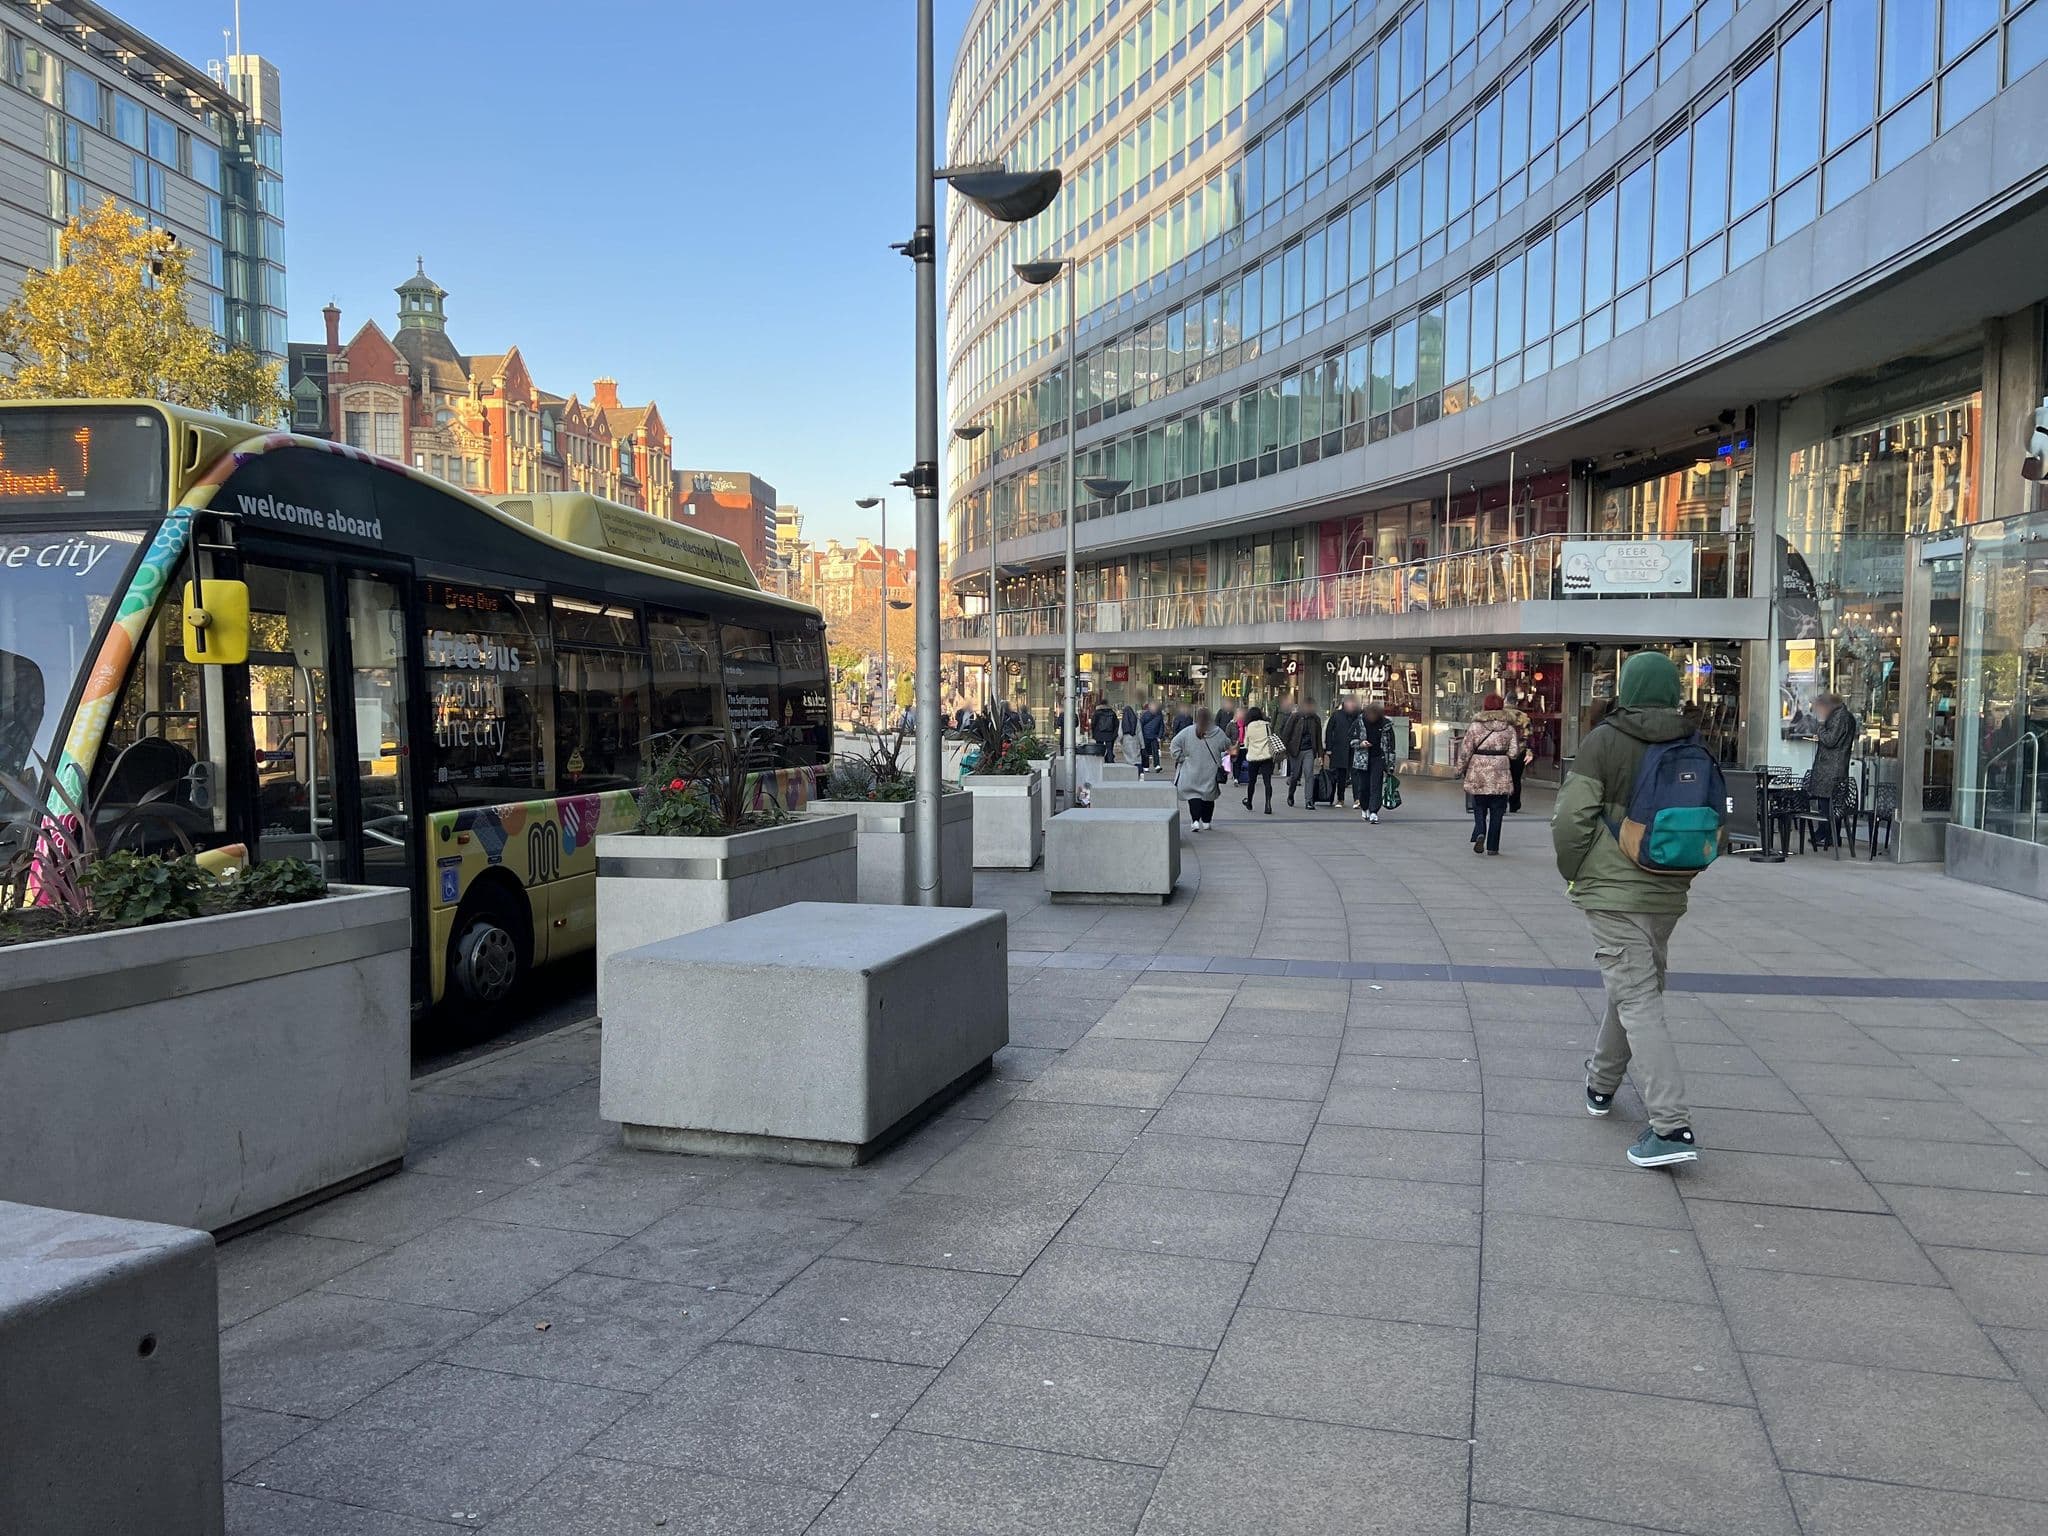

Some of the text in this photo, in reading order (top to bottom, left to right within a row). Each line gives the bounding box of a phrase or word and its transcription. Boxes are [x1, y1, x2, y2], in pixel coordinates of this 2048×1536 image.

[74, 426, 90, 477] 1
[0, 467, 64, 495] treet
[236, 494, 383, 541] welcome aboard
[36, 537, 111, 576] city
[1617, 547, 1648, 556] BEER
[444, 587, 475, 608] Free
[476, 591, 499, 612] Bus
[432, 629, 521, 672] free bus
[1221, 679, 1242, 698] RICE
[1337, 652, 1386, 704] Archie's
[438, 715, 506, 756] the city
